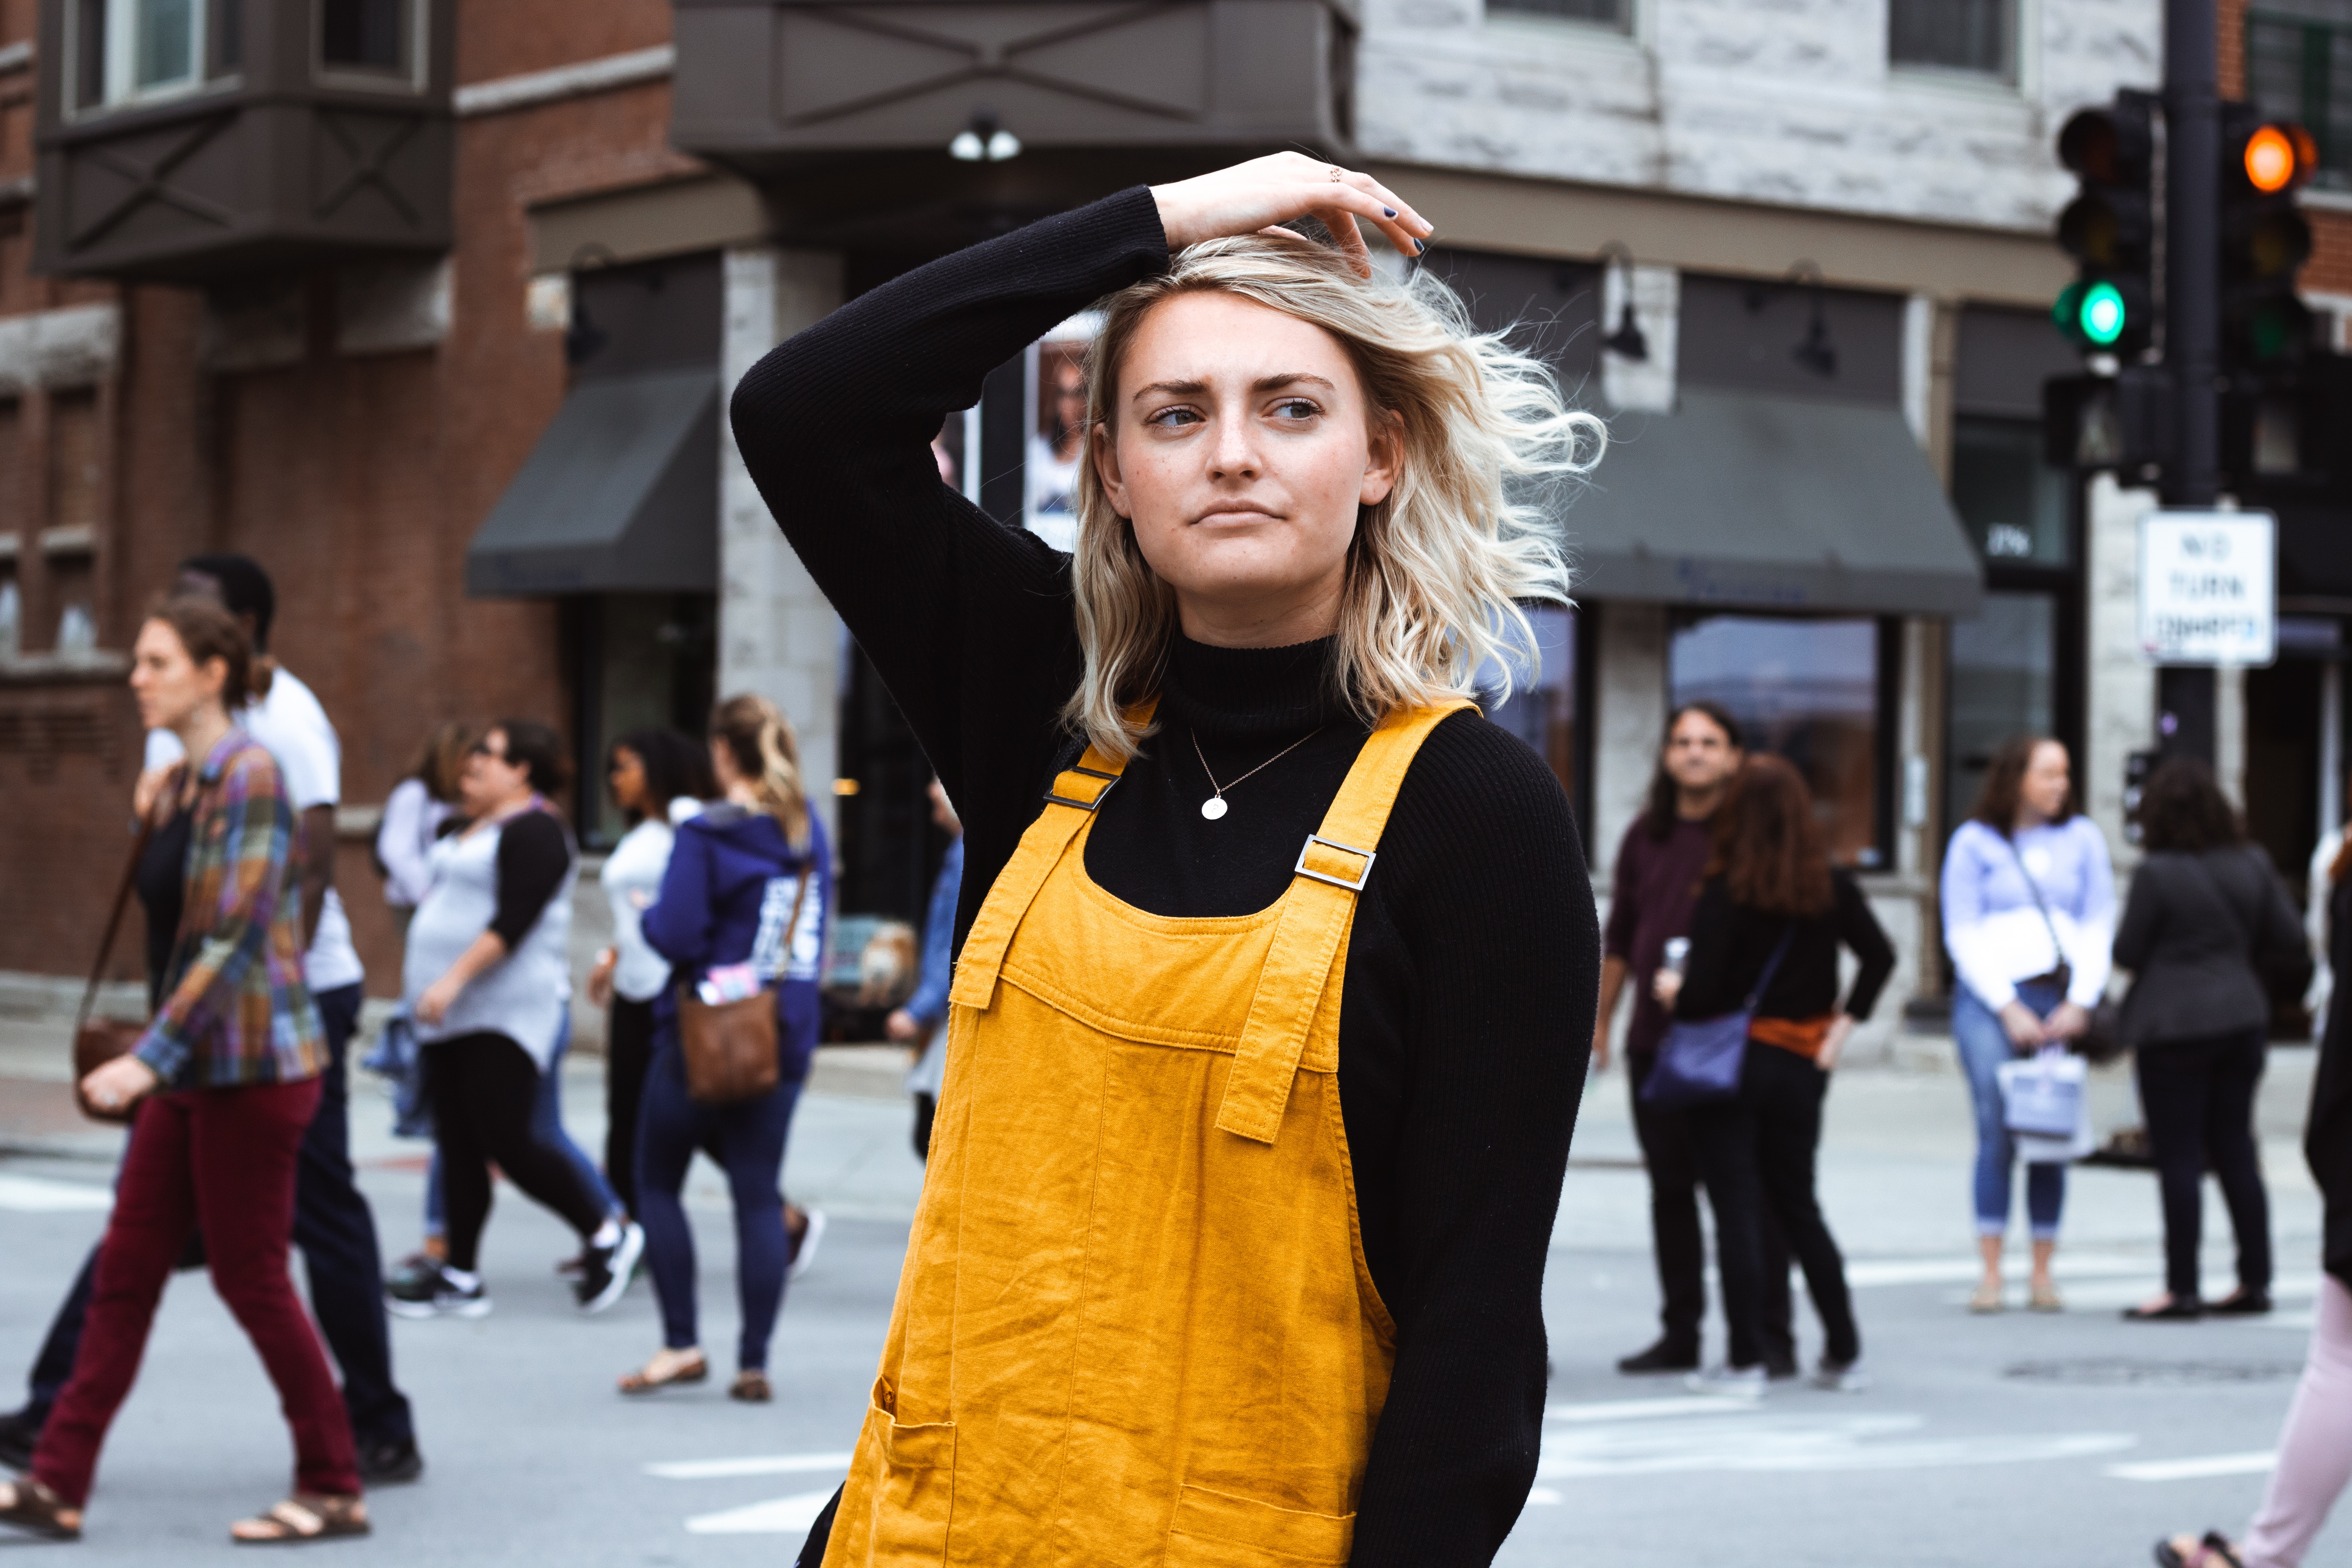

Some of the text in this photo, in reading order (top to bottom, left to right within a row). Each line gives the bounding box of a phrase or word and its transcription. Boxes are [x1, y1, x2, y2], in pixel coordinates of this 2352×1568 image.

[2181, 532, 2230, 561] NO
[2167, 571, 2245, 601] TURN
[1212, 804, 1219, 813] P
